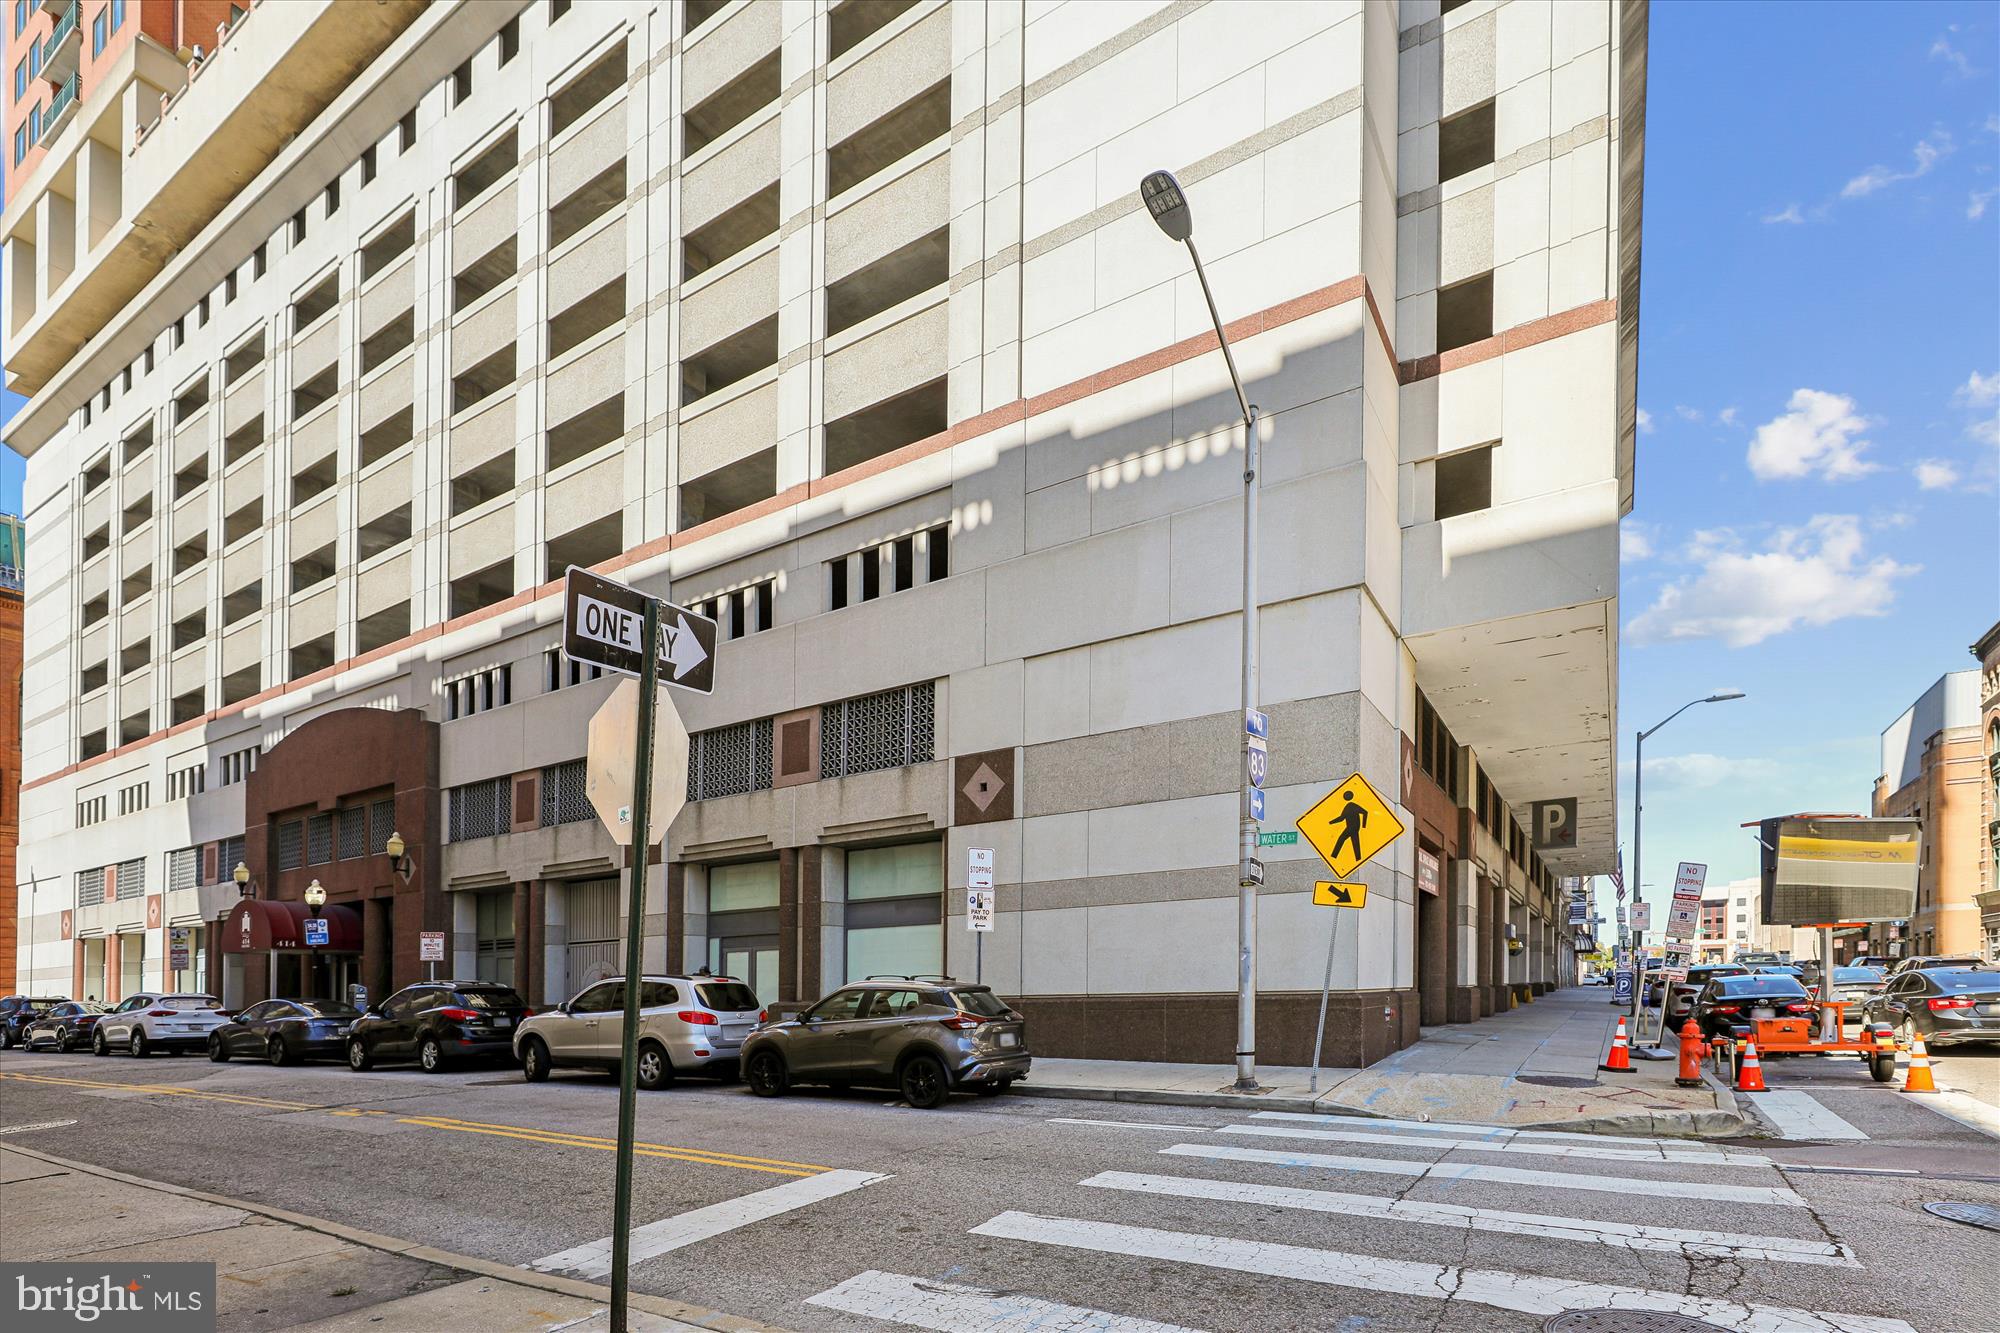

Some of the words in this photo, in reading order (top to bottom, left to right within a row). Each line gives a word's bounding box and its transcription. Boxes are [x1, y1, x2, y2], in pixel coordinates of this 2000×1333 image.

[586, 603, 632, 646] ONE
[640, 620, 678, 658] AY
[1252, 714, 1263, 731] TO
[1251, 752, 1265, 777] 83
[1542, 804, 1567, 844] P
[1261, 833, 1287, 845] WATER
[977, 852, 985, 860] NO
[970, 866, 992, 874] STOPPING
[1686, 867, 1698, 875] NO
[1678, 878, 1702, 886] STOPPING
[1673, 945, 1690, 953] PARKING
[1619, 980, 1629, 991] P
